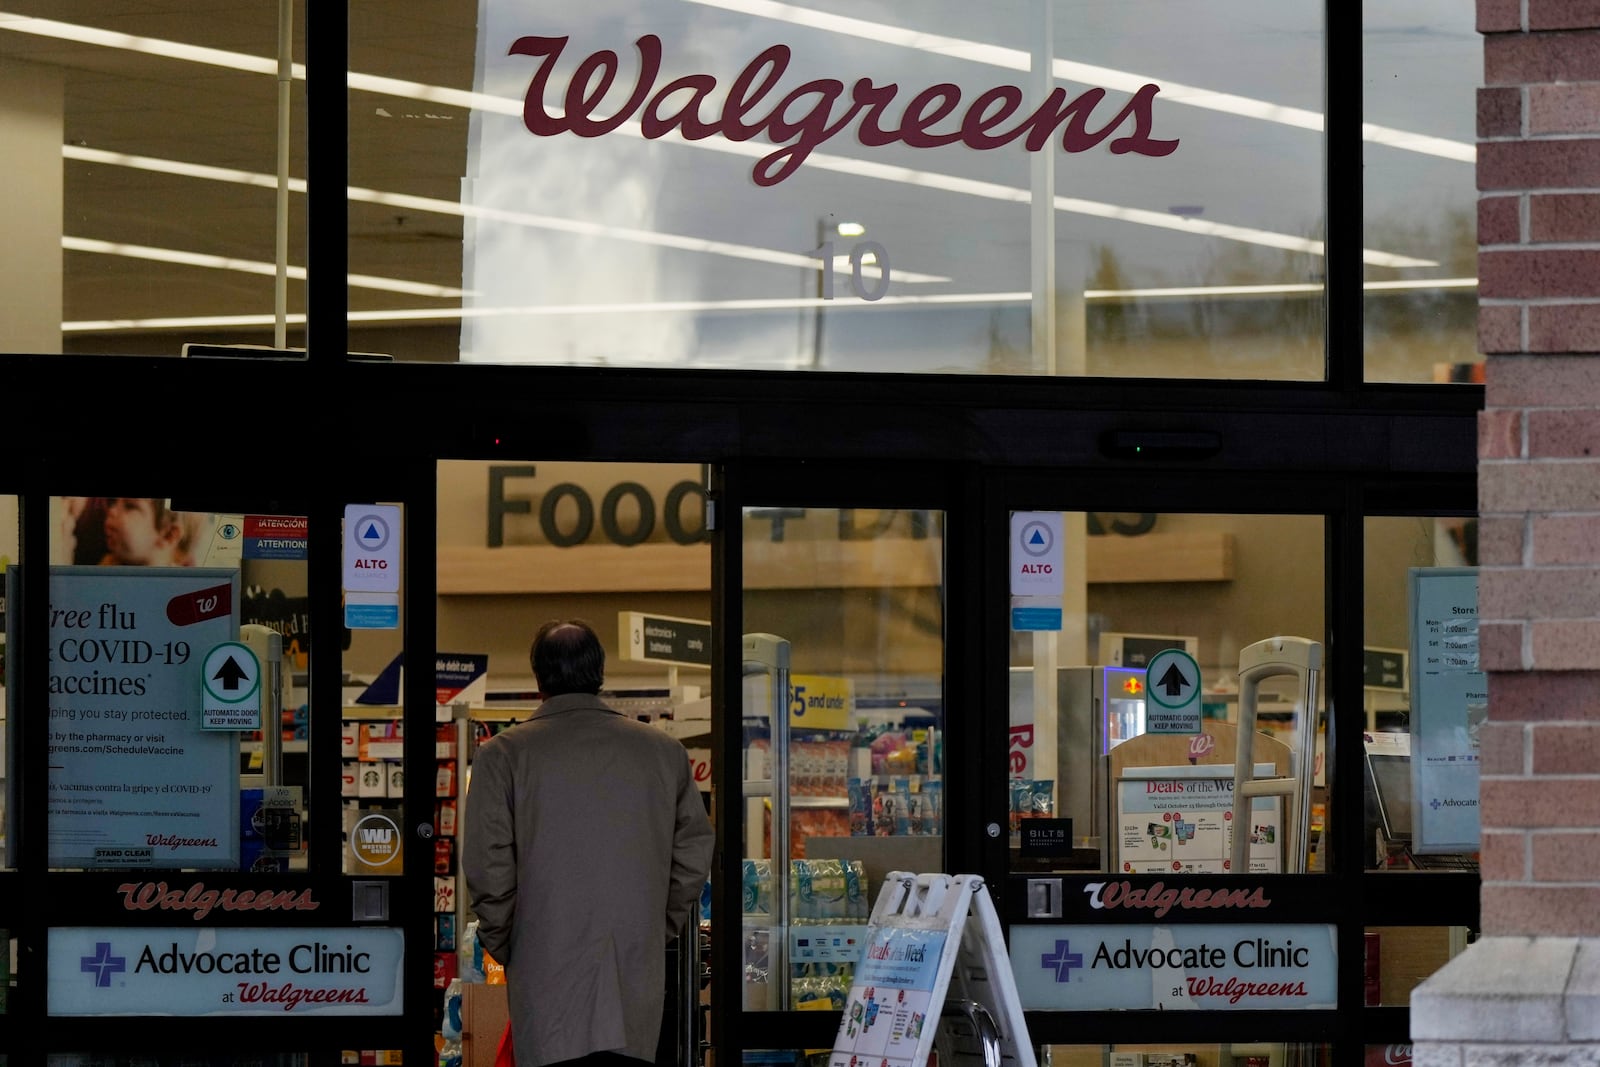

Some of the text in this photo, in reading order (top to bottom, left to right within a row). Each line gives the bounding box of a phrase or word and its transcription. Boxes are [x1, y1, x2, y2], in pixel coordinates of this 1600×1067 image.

[508, 34, 1180, 187] Walgreens
[806, 241, 890, 301] 10
[488, 466, 711, 547] Food
[354, 559, 388, 569] ALTO
[1021, 563, 1053, 574] ALTO
[48, 603, 137, 630] ree flu
[1452, 606, 1475, 615] Store
[59, 638, 191, 665] COVID-19
[48, 670, 152, 696] accines
[808, 693, 826, 708] and
[79, 710, 100, 720] you
[104, 710, 128, 721] stay
[131, 709, 190, 722] protected.
[203, 709, 259, 717] AUTOMATIC DOOR
[226, 718, 253, 726] MOVING
[1170, 722, 1194, 730] MOVING
[55, 732, 67, 742] by
[69, 732, 84, 741] the
[86, 733, 131, 744] pharmacy
[145, 734, 165, 743] visit
[48, 745, 184, 756] greens.com/ScheduleVaccine
[95, 784, 122, 793] contra
[123, 784, 131, 793] la
[1146, 779, 1234, 794] Deals of the We
[1442, 799, 1478, 807] Advocate
[145, 833, 218, 850] Walgreens
[117, 880, 320, 920] Walgreens
[1083, 881, 1272, 919] Walgreens
[134, 943, 371, 974] Advocate Clinic
[1091, 938, 1310, 969] Advocate Clinic
[222, 982, 370, 1011] at Walgreens
[1172, 977, 1308, 1005] at Walgreens
